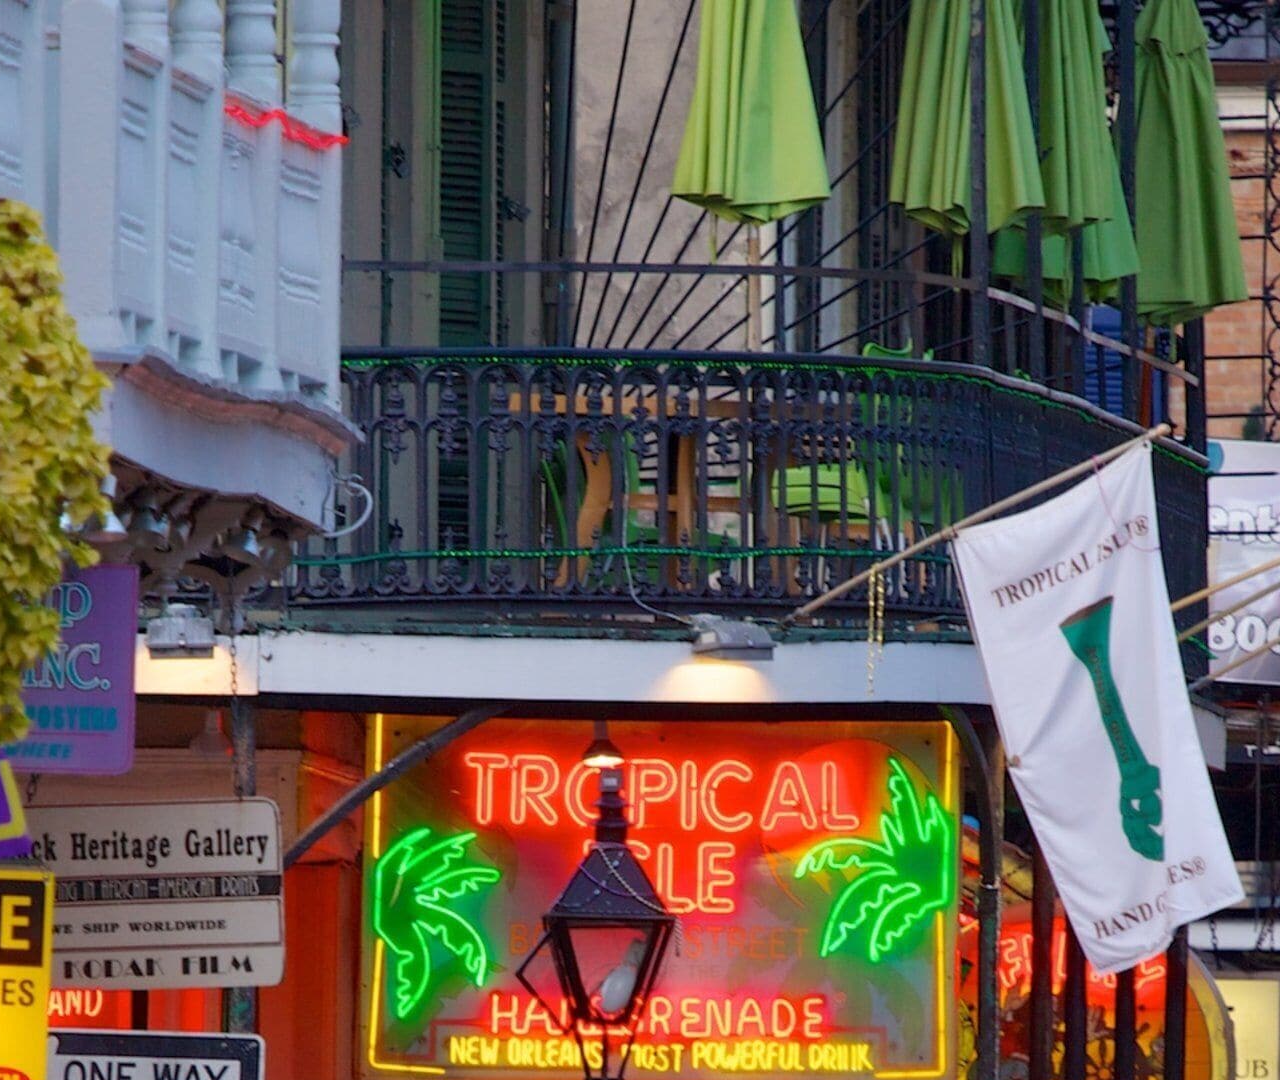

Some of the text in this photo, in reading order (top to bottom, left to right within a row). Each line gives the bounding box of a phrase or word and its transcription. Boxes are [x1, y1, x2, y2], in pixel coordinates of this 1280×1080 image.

[989, 551, 1094, 610] TROPICAL
[464, 751, 859, 832] TROPICAL
[70, 831, 171, 868] Heritage
[185, 828, 269, 864] Gallery
[583, 842, 736, 914] LE
[83, 922, 121, 935] SHIP
[129, 919, 227, 934] WORLDWIDE
[1094, 898, 1153, 941] HAND
[64, 954, 254, 980] KODAK FILM
[449, 1035, 500, 1065] NEW
[691, 1039, 805, 1071] POWERFUL
[808, 1043, 874, 1073] DRINK
